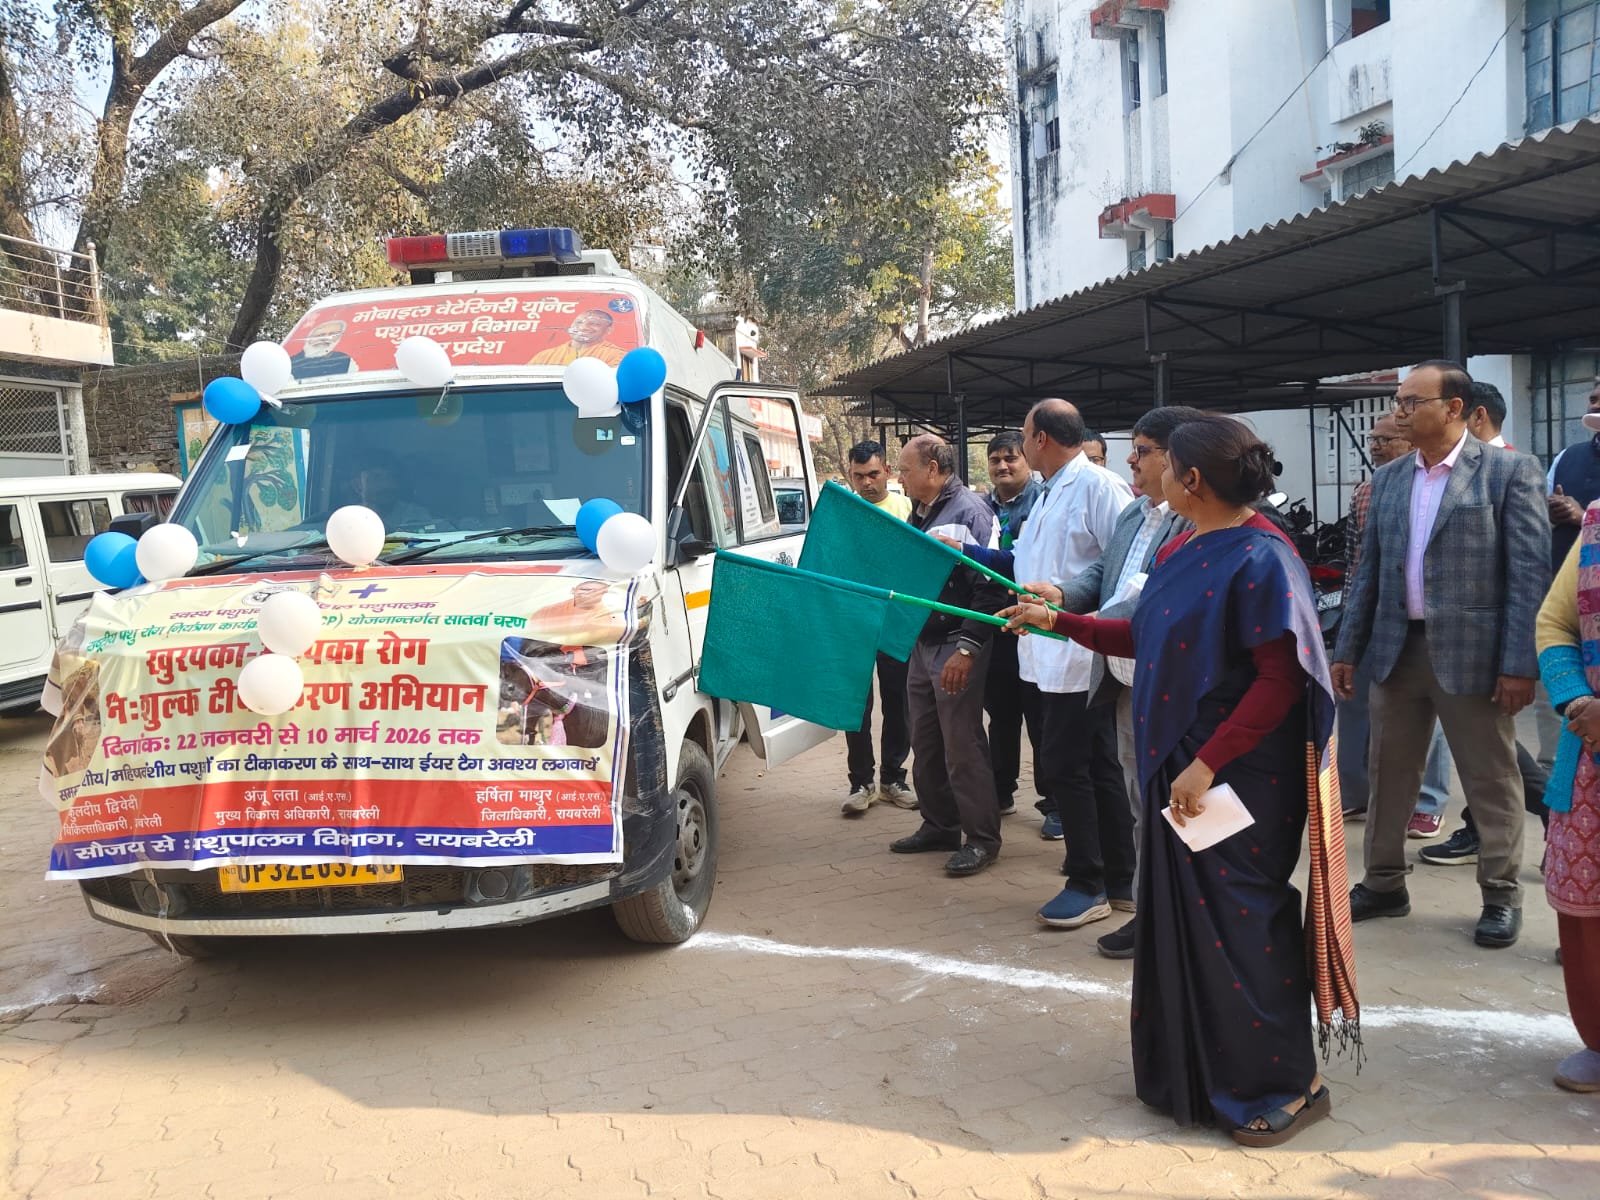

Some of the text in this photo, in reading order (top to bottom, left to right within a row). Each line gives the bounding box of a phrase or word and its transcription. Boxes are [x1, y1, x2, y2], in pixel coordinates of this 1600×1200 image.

[352, 305, 432, 323] मोबाइल
[522, 297, 579, 319] यूनिट
[375, 317, 541, 344] पशुपालन विभाग
[453, 337, 506, 358] प्रदेश
[169, 609, 211, 620] स्वस्थ
[357, 601, 439, 613] पशुपालक
[119, 629, 137, 646] पशु
[141, 625, 166, 638] रोग
[218, 618, 258, 631] कार्यक्र
[443, 612, 494, 627] सातवां
[494, 615, 528, 629] चरण
[377, 631, 431, 666] रोग
[359, 674, 488, 713] अभियान
[201, 722, 273, 748] जनवरी
[278, 722, 300, 746] से
[307, 728, 328, 744] 10
[334, 721, 380, 744] मार्च
[384, 728, 431, 744] 2026
[438, 728, 483, 745] तक
[216, 758, 240, 772] का
[244, 753, 316, 772] टीकाकरण
[320, 753, 338, 770] के
[342, 756, 414, 770] साथ-साथ
[419, 752, 453, 772] ईयर
[458, 753, 484, 771] टैग
[488, 757, 538, 771] अवश्य
[542, 756, 600, 772] लगवायें
[105, 794, 139, 814] द्विवेदी
[244, 786, 270, 806] अंजू
[272, 789, 299, 802] लता
[475, 786, 513, 803] हर्षिता
[519, 788, 553, 807] माथुर
[214, 805, 380, 826] मुख्य विकास अधिकारी, रायबरेली
[556, 805, 601, 820] रायबरेली
[151, 835, 176, 853] से
[312, 827, 404, 848] विभाग,
[416, 827, 536, 848] रायबरेली
